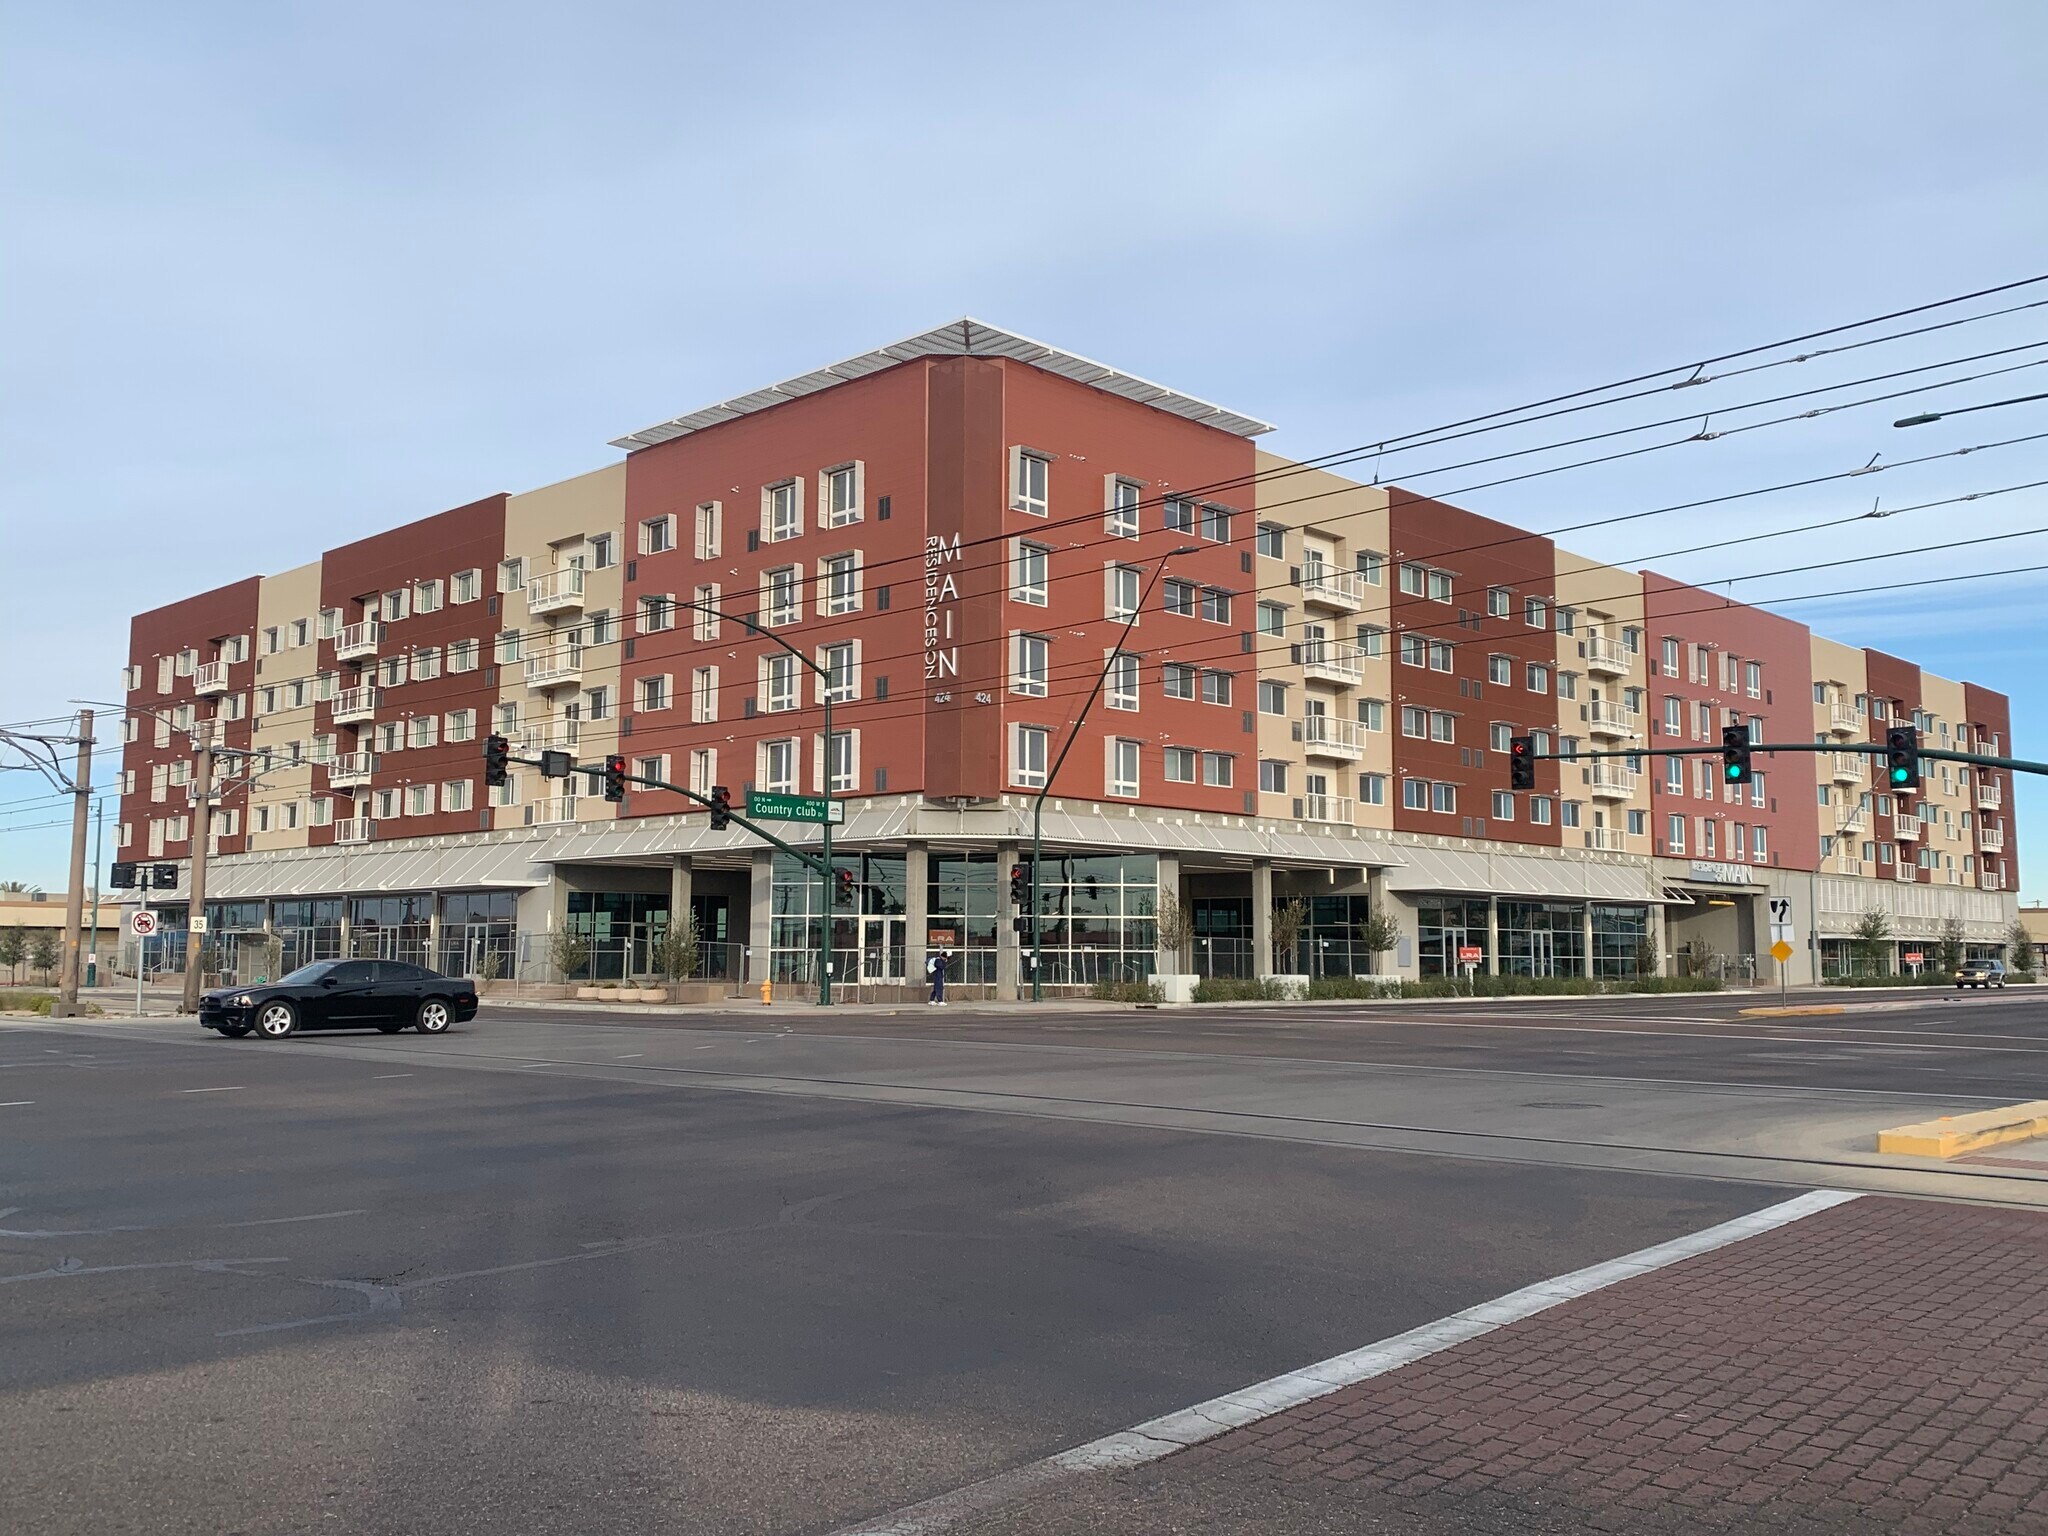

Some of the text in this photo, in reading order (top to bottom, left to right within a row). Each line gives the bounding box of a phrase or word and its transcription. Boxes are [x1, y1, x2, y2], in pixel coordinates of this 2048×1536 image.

[925, 536, 937, 679] RESIDENCES ON
[938, 532, 962, 678] MAIN
[934, 691, 951, 703] 424
[975, 692, 991, 703] 424
[755, 803, 792, 817] Country
[796, 806, 817, 817] Club
[1725, 864, 1753, 884] MAIN
[193, 920, 204, 930] 35
